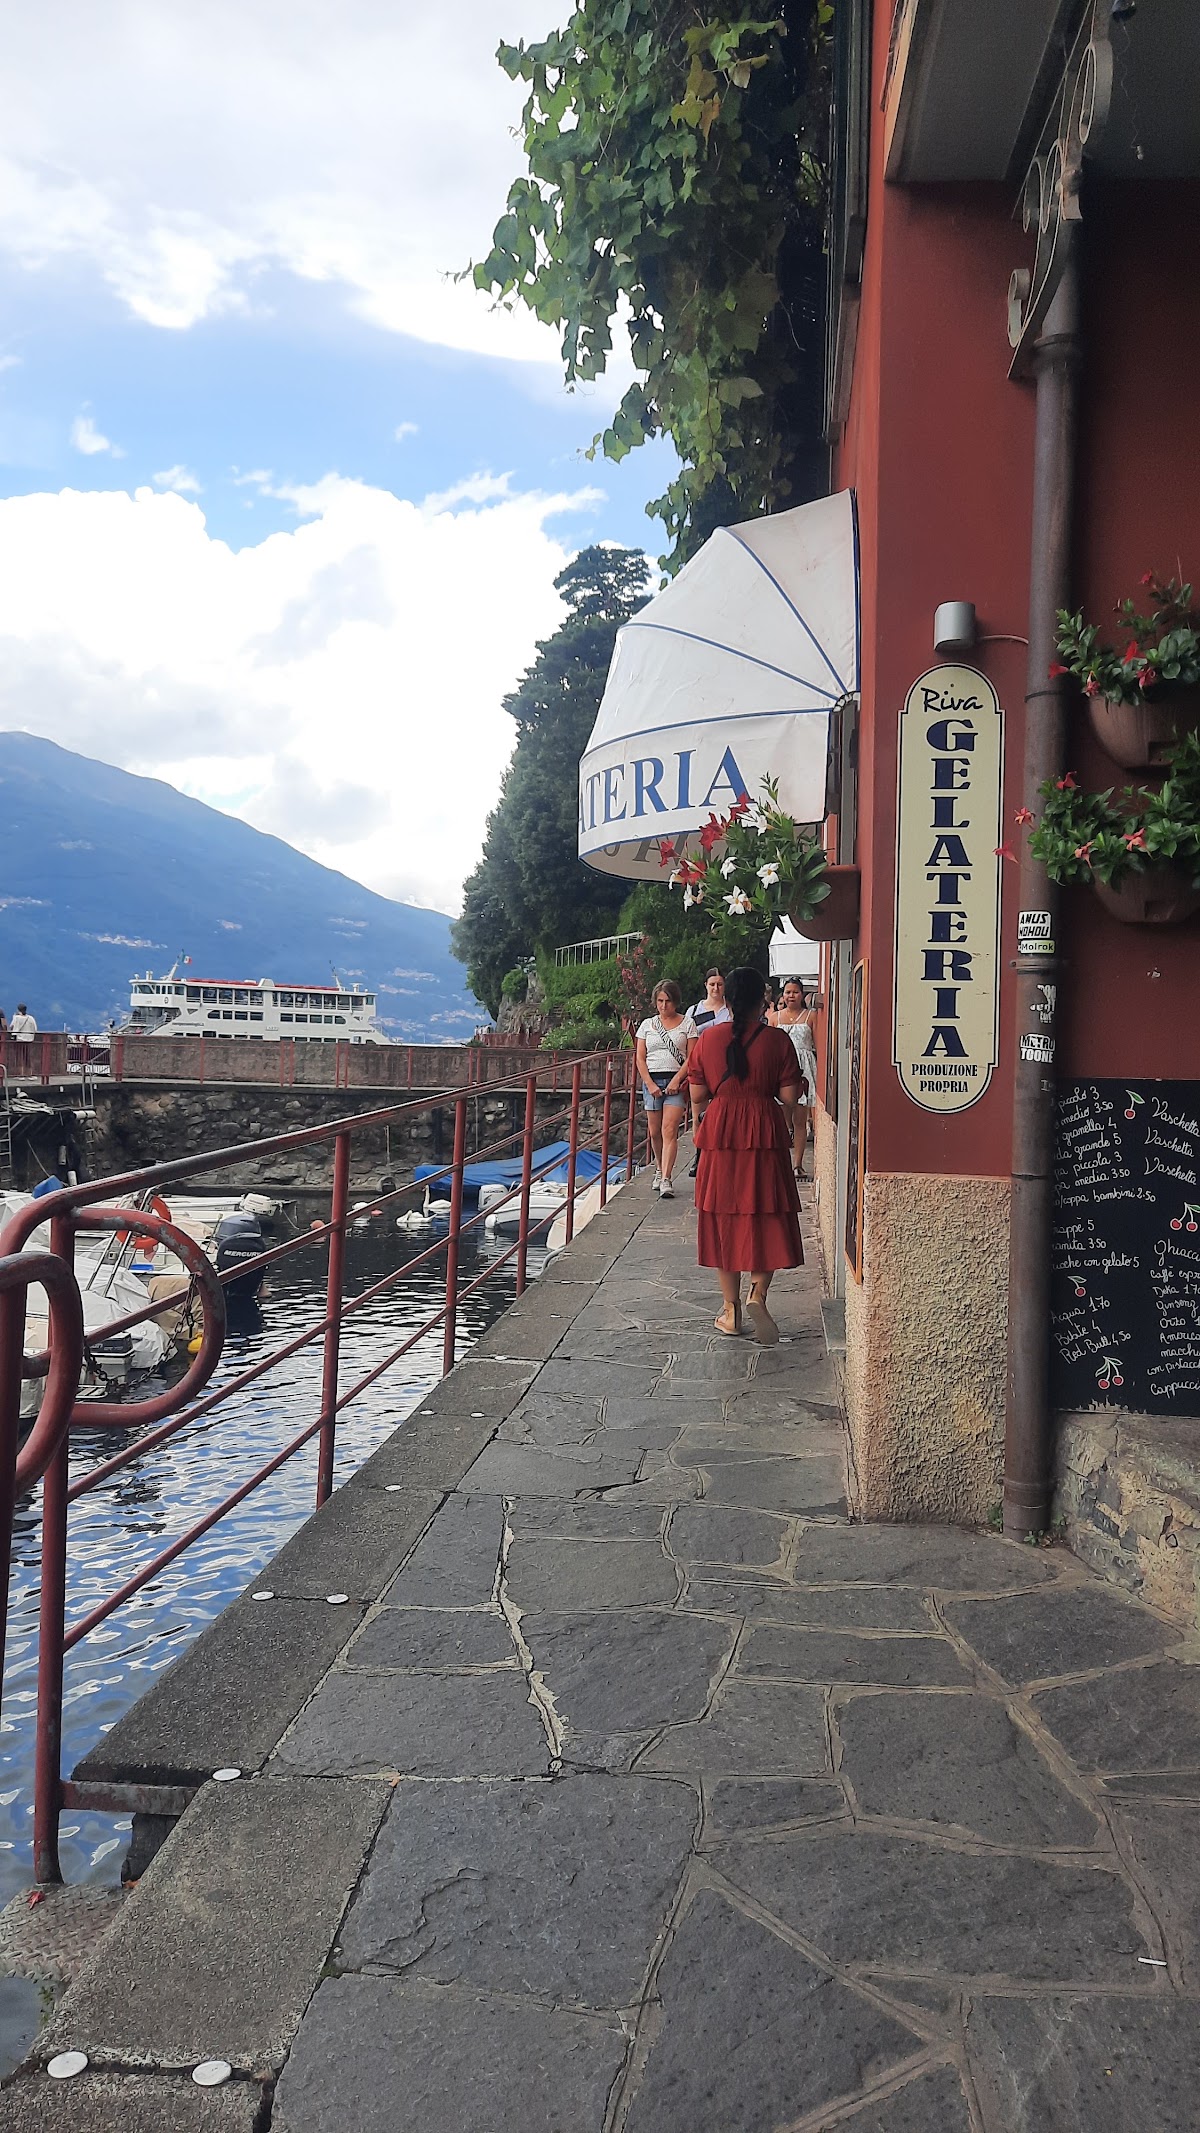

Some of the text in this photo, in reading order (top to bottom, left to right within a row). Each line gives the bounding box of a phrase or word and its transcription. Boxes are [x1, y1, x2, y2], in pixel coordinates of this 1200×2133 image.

[920, 687, 984, 712] Riva
[920, 719, 978, 1058] GELATERIA
[911, 1063, 978, 1077] PRODUZIONE
[919, 1080, 969, 1093] PROPRIA
[1089, 1086, 1100, 1101] 3
[1107, 1116, 1118, 1129] 4
[1073, 1131, 1111, 1161] grande
[1112, 1132, 1122, 1145] 5
[1072, 1151, 1112, 1177] piccola
[1113, 1151, 1123, 1163] 3
[1074, 1168, 1110, 1187] media
[1087, 1219, 1095, 1231] 5
[223, 1249, 262, 1258] MERCURY
[1083, 1258, 1101, 1267] con
[1132, 1256, 1140, 1268] 5
[1146, 1365, 1165, 1376] con
